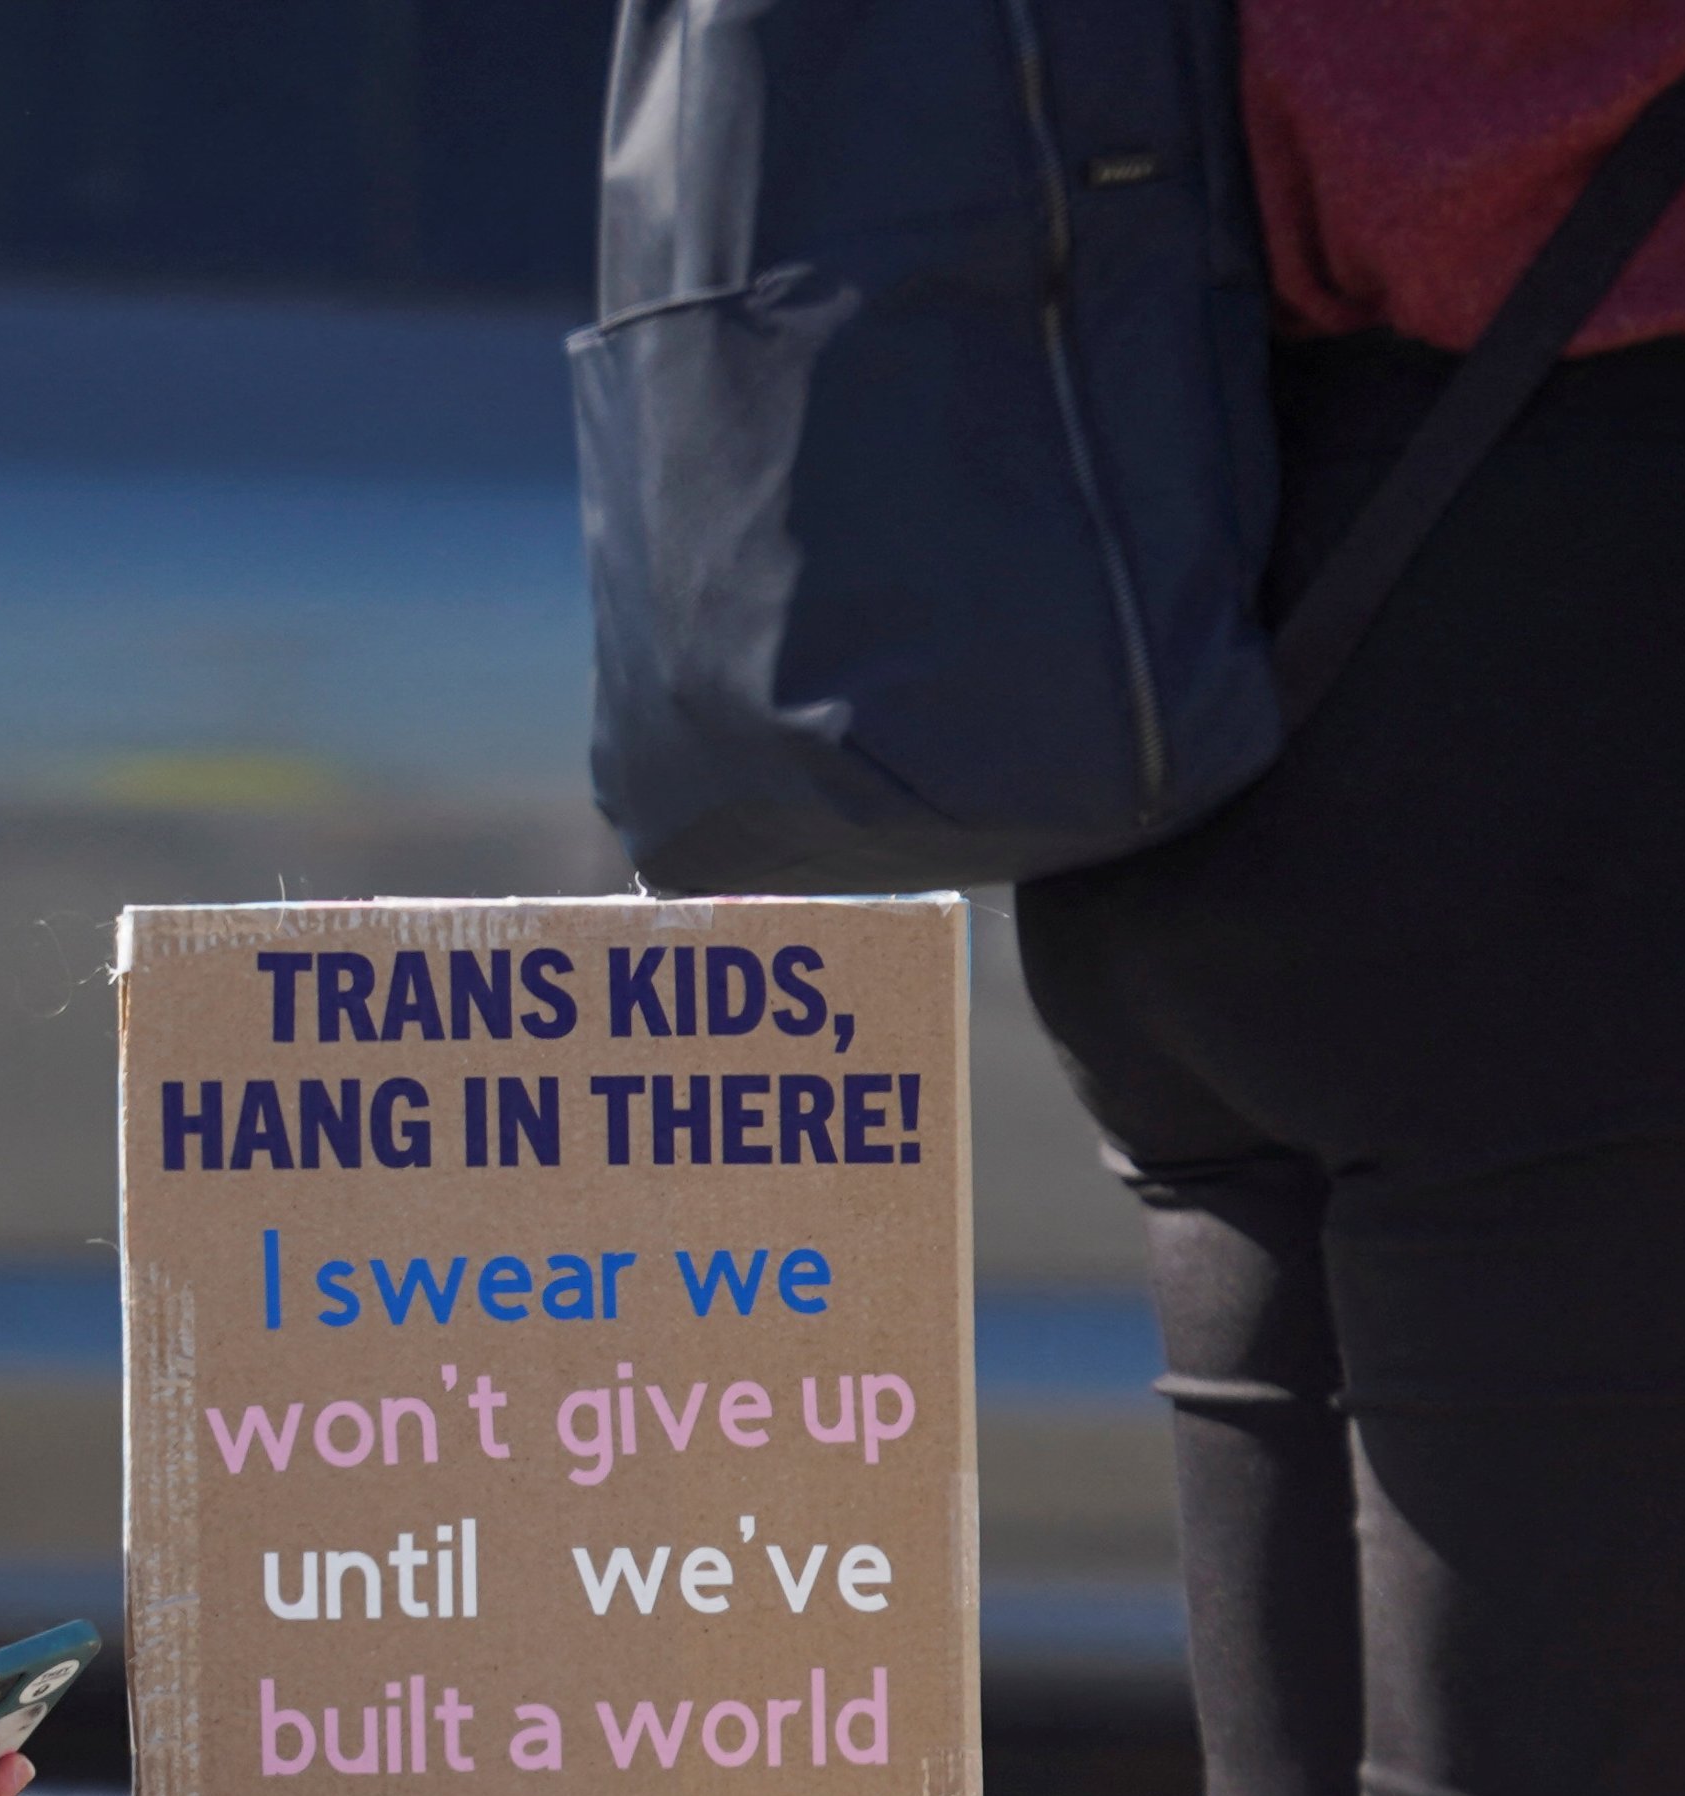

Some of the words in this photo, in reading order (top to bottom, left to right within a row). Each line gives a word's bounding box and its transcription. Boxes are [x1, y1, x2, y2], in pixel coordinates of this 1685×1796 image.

[258, 948, 577, 1043] TRANS
[609, 945, 855, 1054] KIDS,
[162, 1077, 432, 1171] HANG
[464, 1077, 561, 1167] IN
[590, 1074, 922, 1165] THERE!
[262, 1228, 283, 1331] I
[314, 1249, 639, 1329] swear
[673, 1247, 834, 1318] we
[206, 1364, 510, 1474] won't
[558, 1362, 773, 1486] give
[802, 1372, 917, 1464] up
[263, 1518, 478, 1620] until
[572, 1516, 892, 1615] we've
[260, 1675, 474, 1776] built
[510, 1703, 562, 1770] a
[596, 1667, 889, 1768] world
